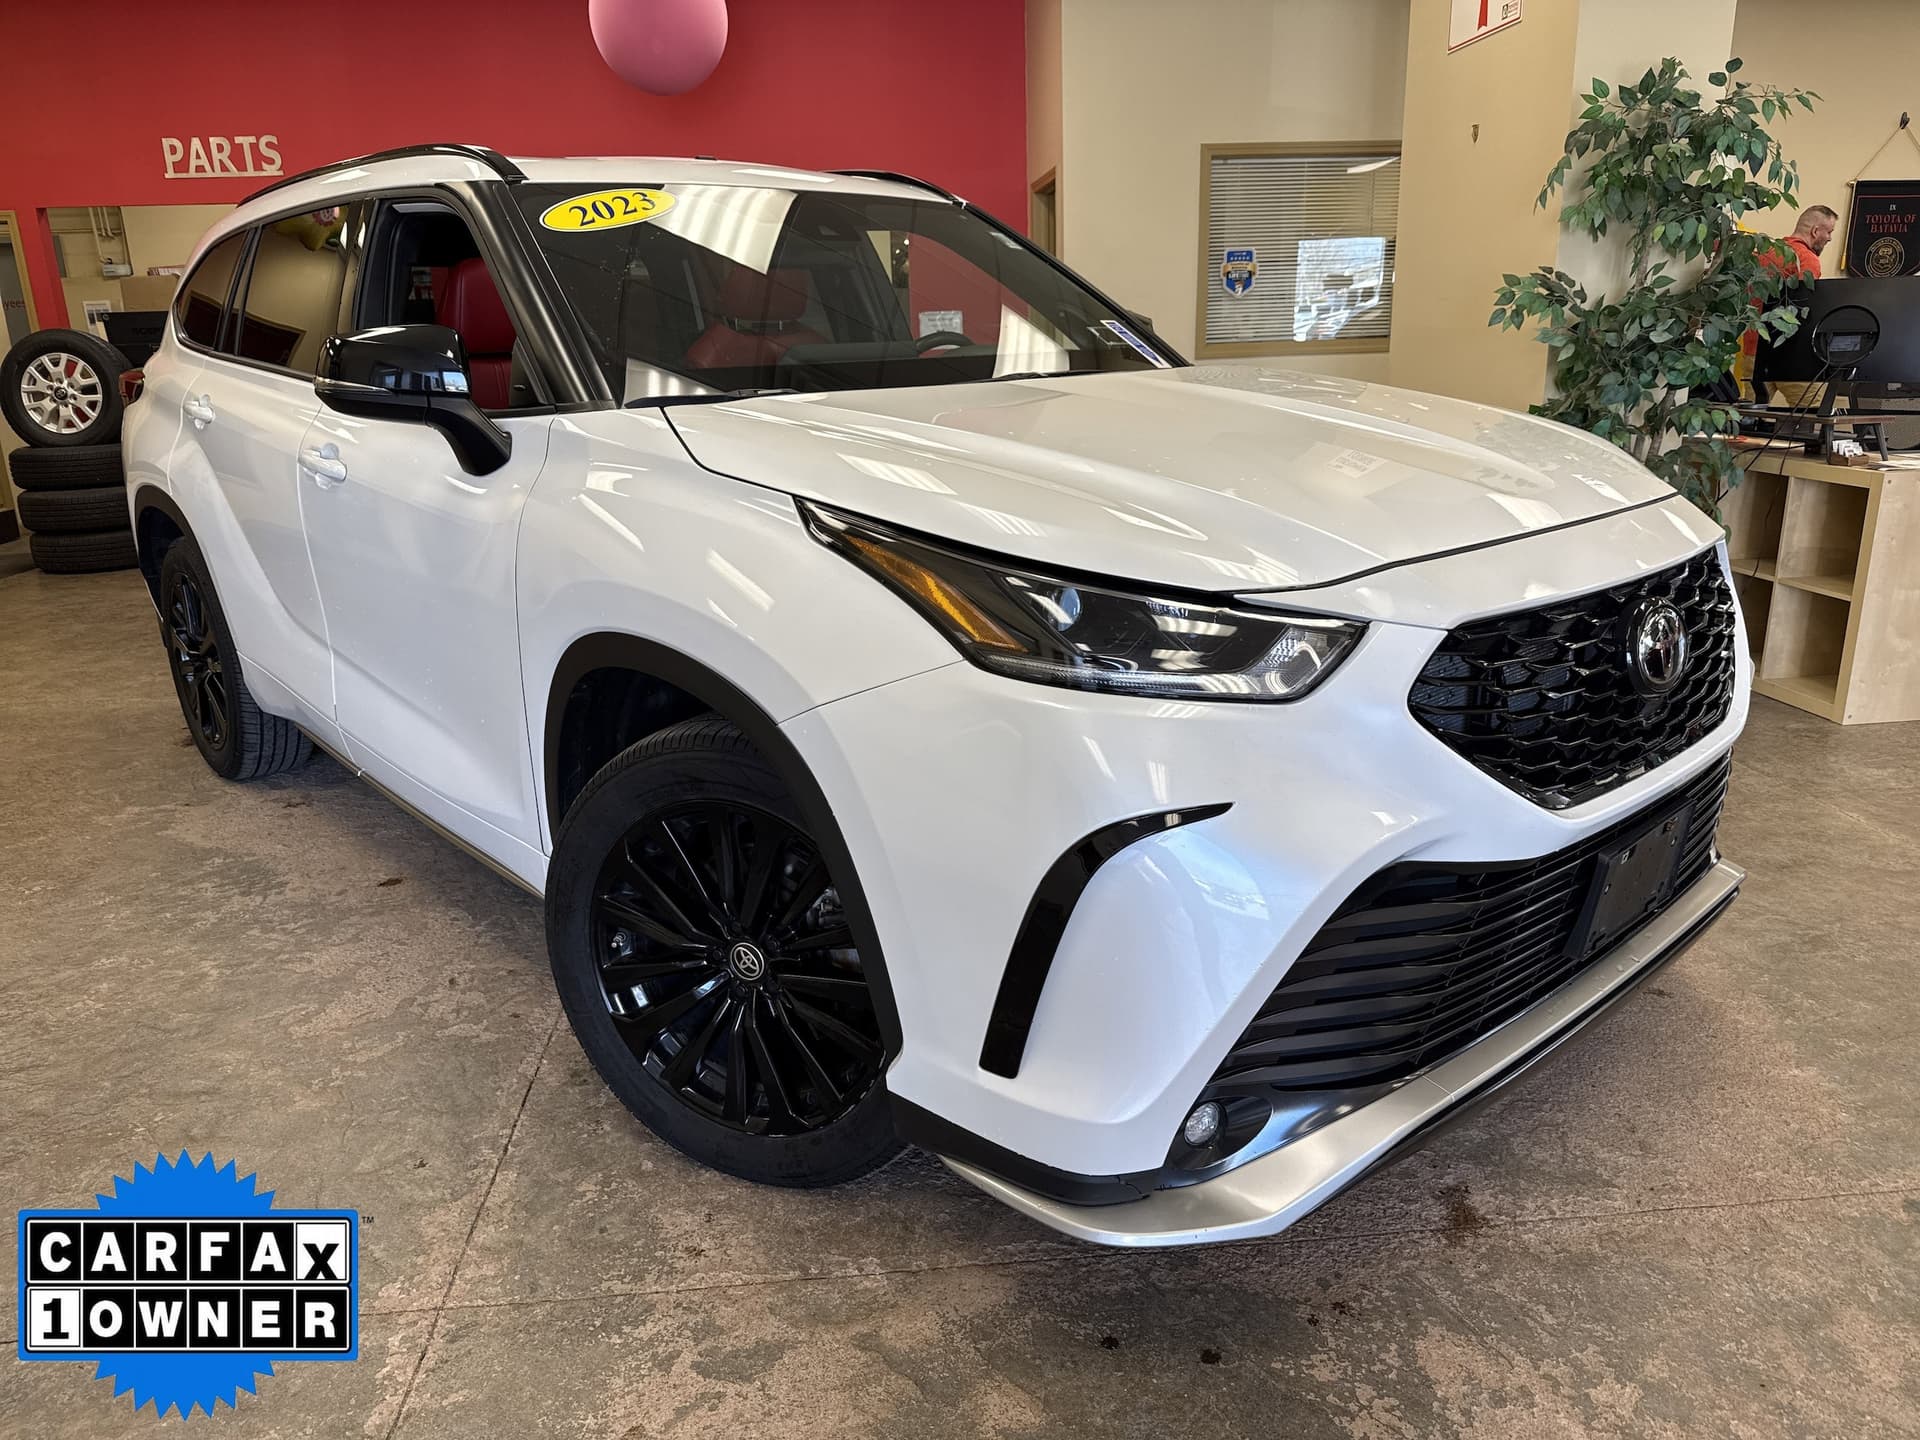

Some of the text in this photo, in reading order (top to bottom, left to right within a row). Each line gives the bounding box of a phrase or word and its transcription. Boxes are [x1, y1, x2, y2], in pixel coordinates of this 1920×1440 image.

[161, 134, 284, 178] PARTS
[569, 192, 656, 226] 2023
[1865, 214, 1917, 223] TOYOTA OF
[1870, 224, 1907, 232] BATAVIA
